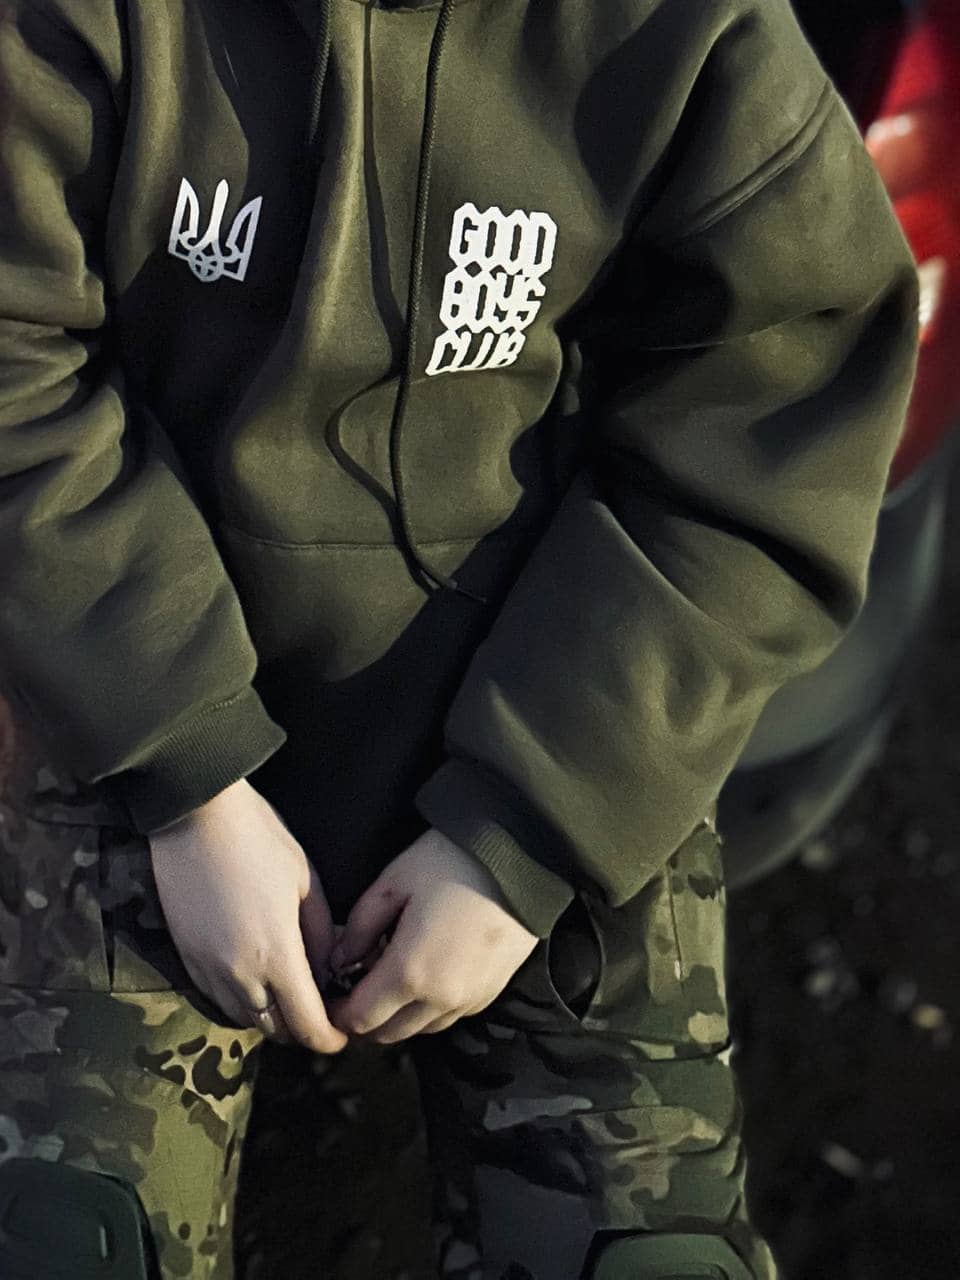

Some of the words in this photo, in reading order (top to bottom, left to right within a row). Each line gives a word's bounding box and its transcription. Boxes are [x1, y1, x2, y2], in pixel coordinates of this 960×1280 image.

[449, 202, 557, 279] GOOD
[440, 267, 546, 334] BOYS
[425, 329, 526, 376] CLUB
